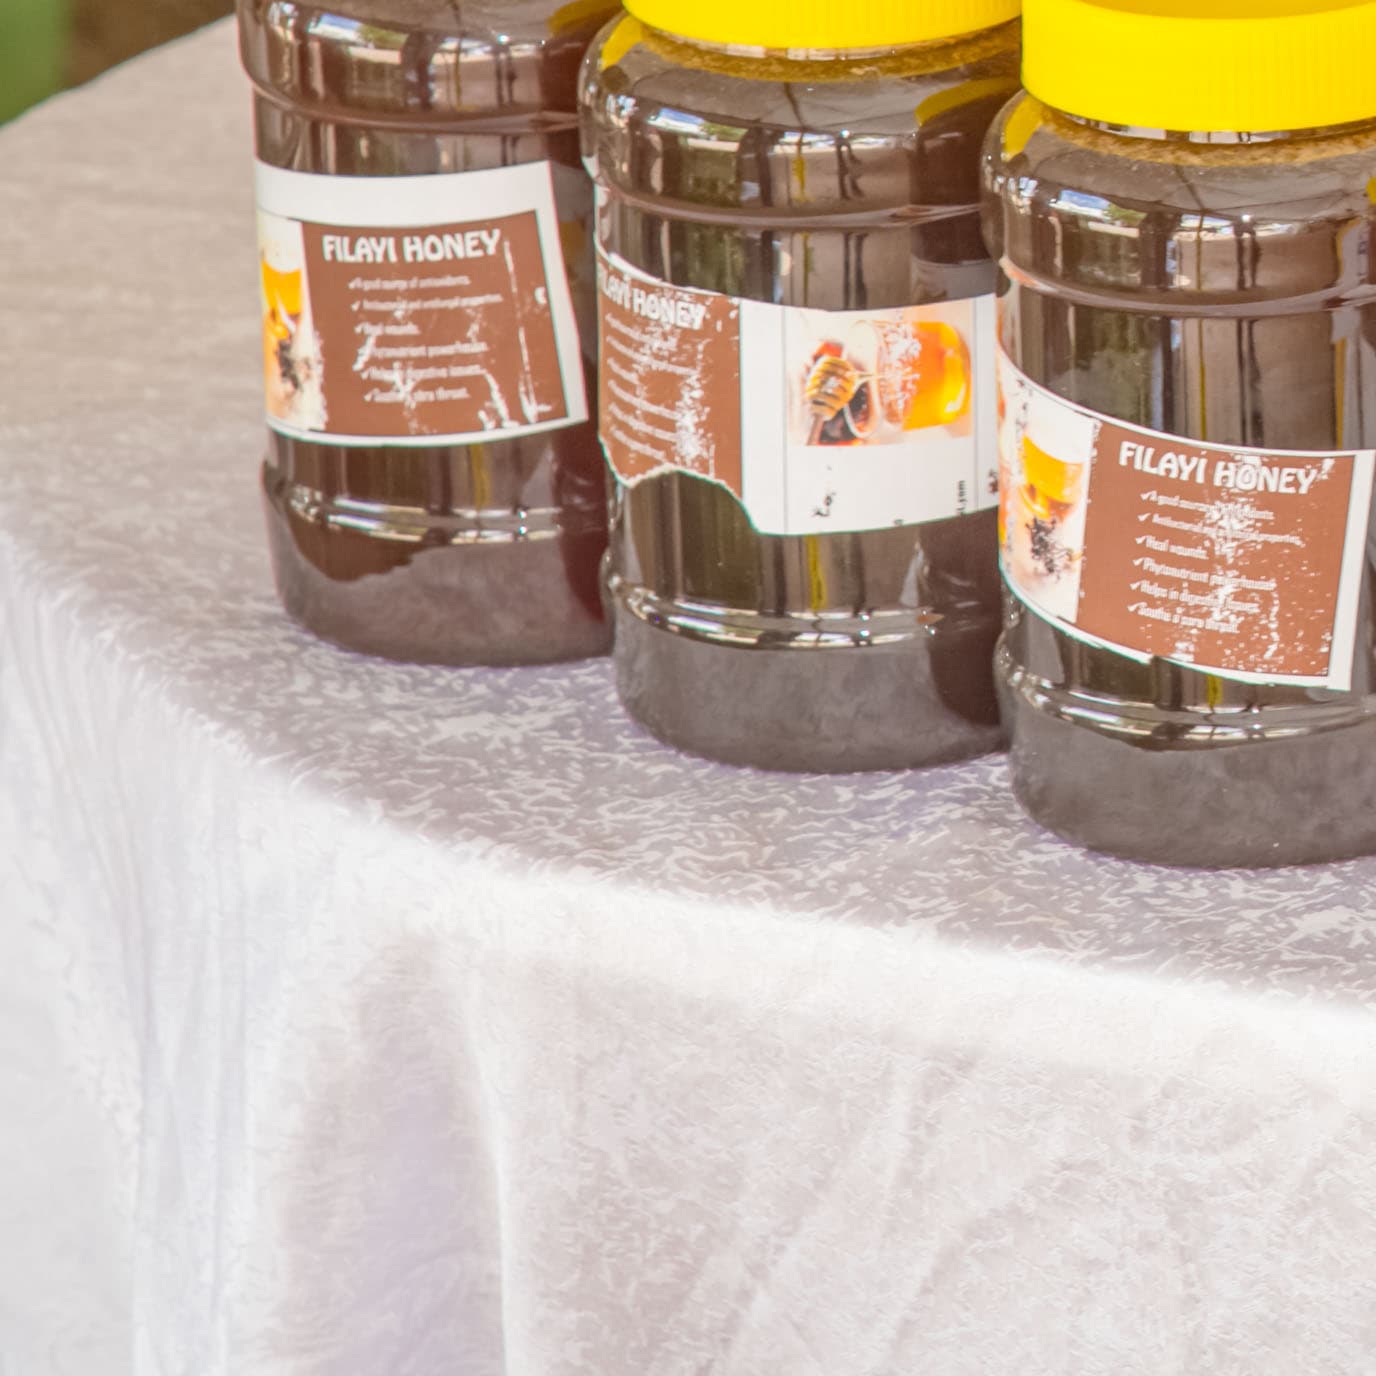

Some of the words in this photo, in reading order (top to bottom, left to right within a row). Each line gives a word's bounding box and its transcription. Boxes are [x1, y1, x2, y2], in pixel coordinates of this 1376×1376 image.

[321, 234, 397, 264] FILAYI
[402, 228, 501, 263] HONEY
[633, 289, 706, 331] HONEY
[1118, 440, 1208, 484] FILAYI
[1213, 460, 1319, 495] HONEY
